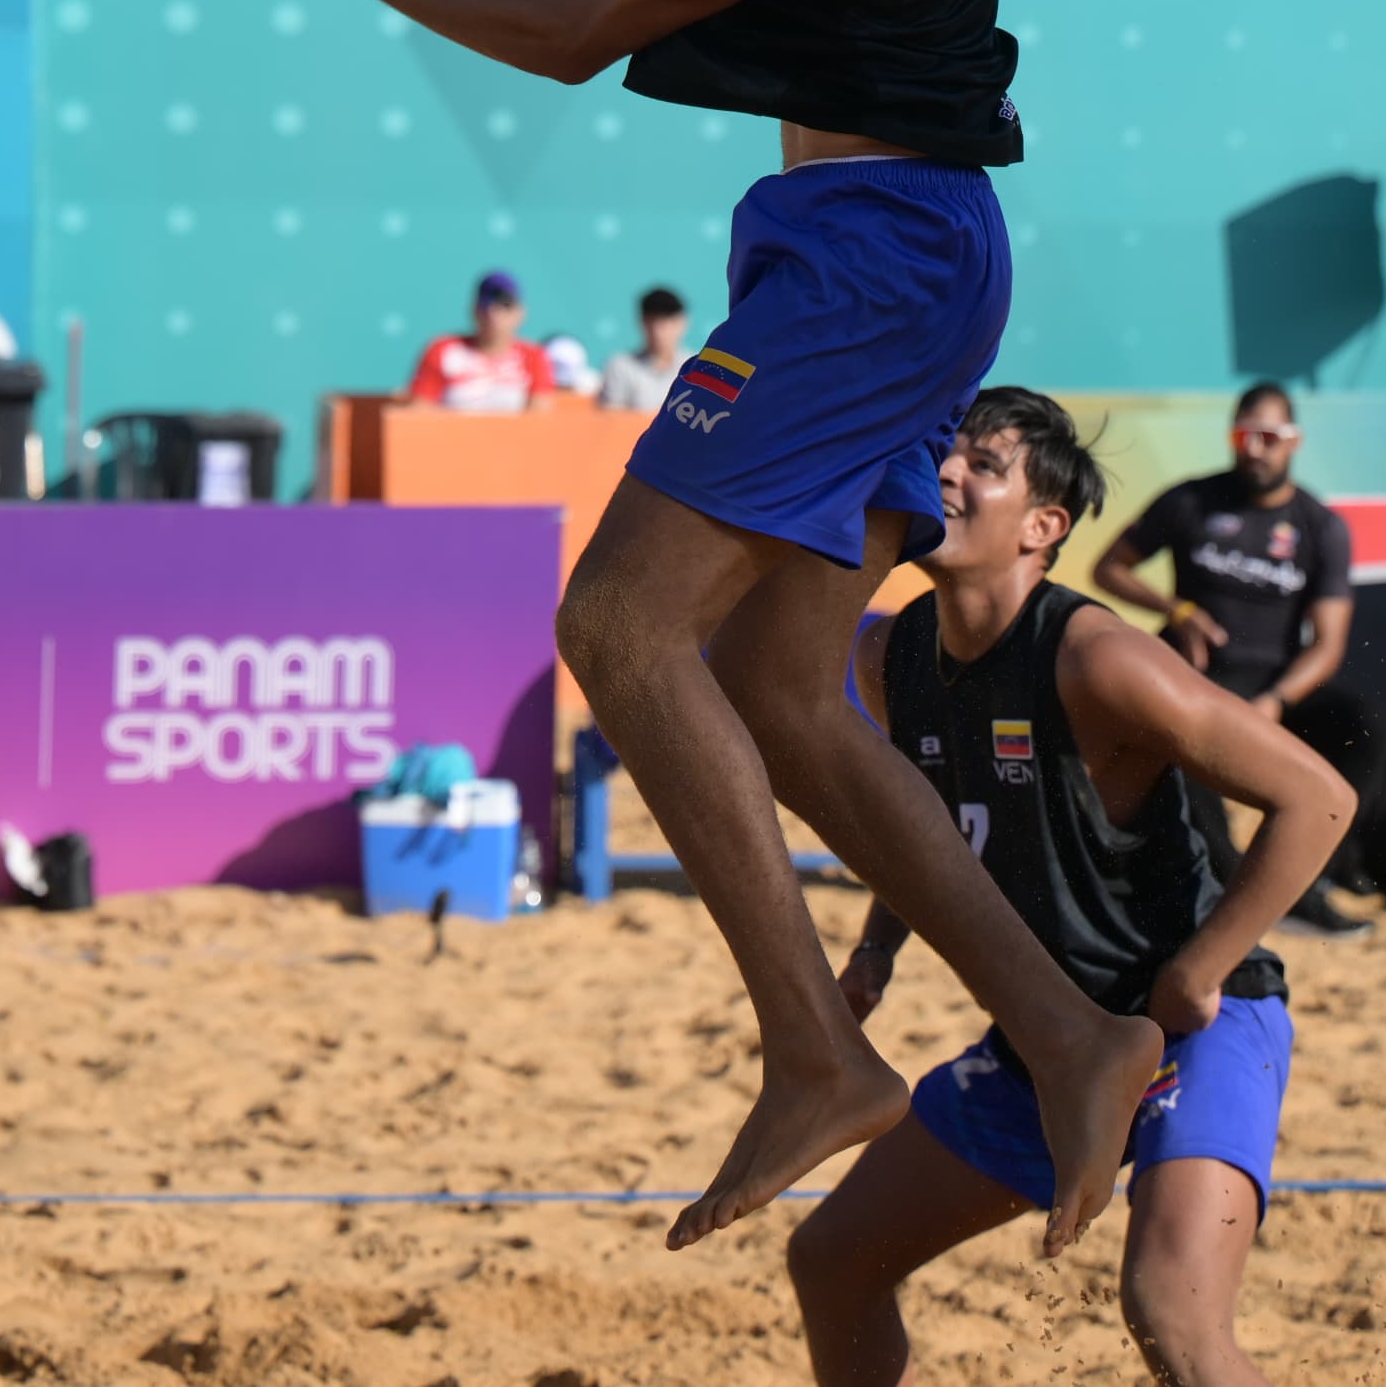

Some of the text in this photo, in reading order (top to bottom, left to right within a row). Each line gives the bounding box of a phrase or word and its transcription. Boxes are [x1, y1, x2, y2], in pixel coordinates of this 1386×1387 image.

[114, 635, 394, 707] PANAM
[103, 711, 398, 782] SPORTS
[992, 760, 1035, 785] VEN
